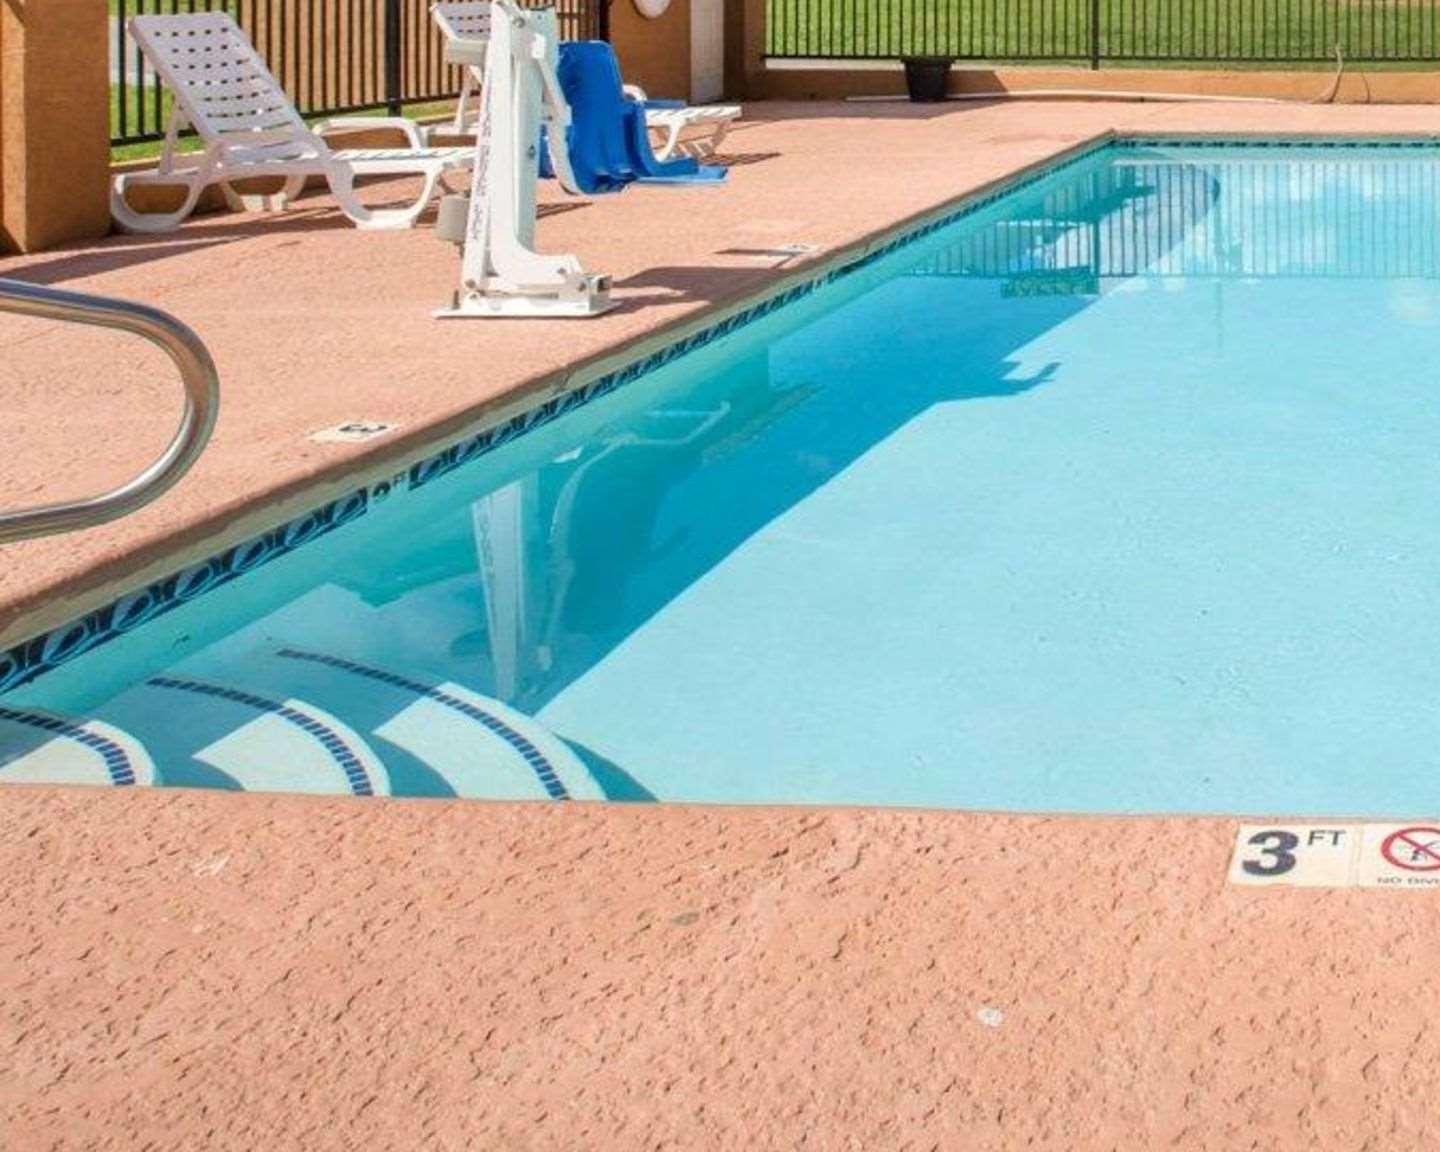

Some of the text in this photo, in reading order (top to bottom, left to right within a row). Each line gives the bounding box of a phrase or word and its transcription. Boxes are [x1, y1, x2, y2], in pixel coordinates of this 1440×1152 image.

[1242, 829, 1347, 876] 3 FT
[1376, 876, 1402, 884] NO
